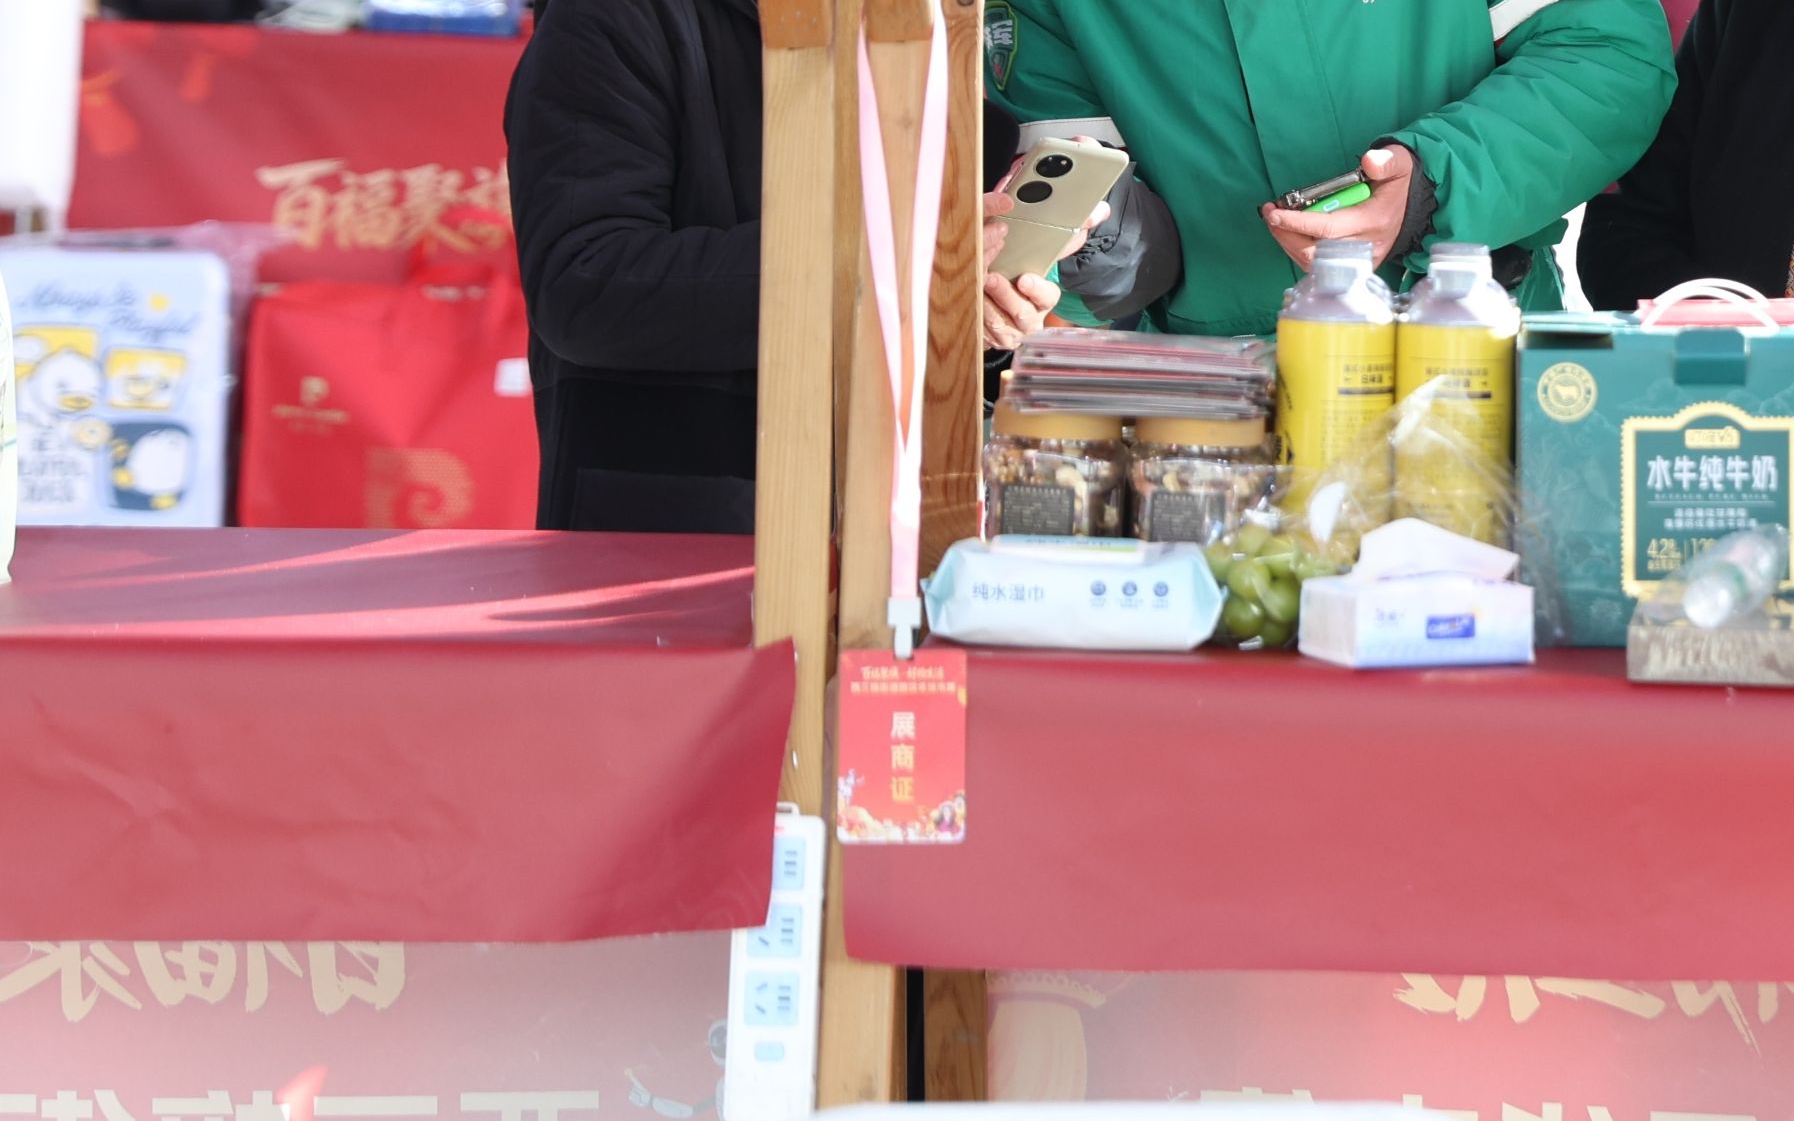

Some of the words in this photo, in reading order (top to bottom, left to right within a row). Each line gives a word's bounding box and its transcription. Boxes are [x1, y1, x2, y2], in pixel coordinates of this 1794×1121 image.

[1647, 455, 1778, 491] 水牛纯牛奶
[972, 582, 1044, 601] 纯水湿巾
[891, 711, 915, 803] 展商证
